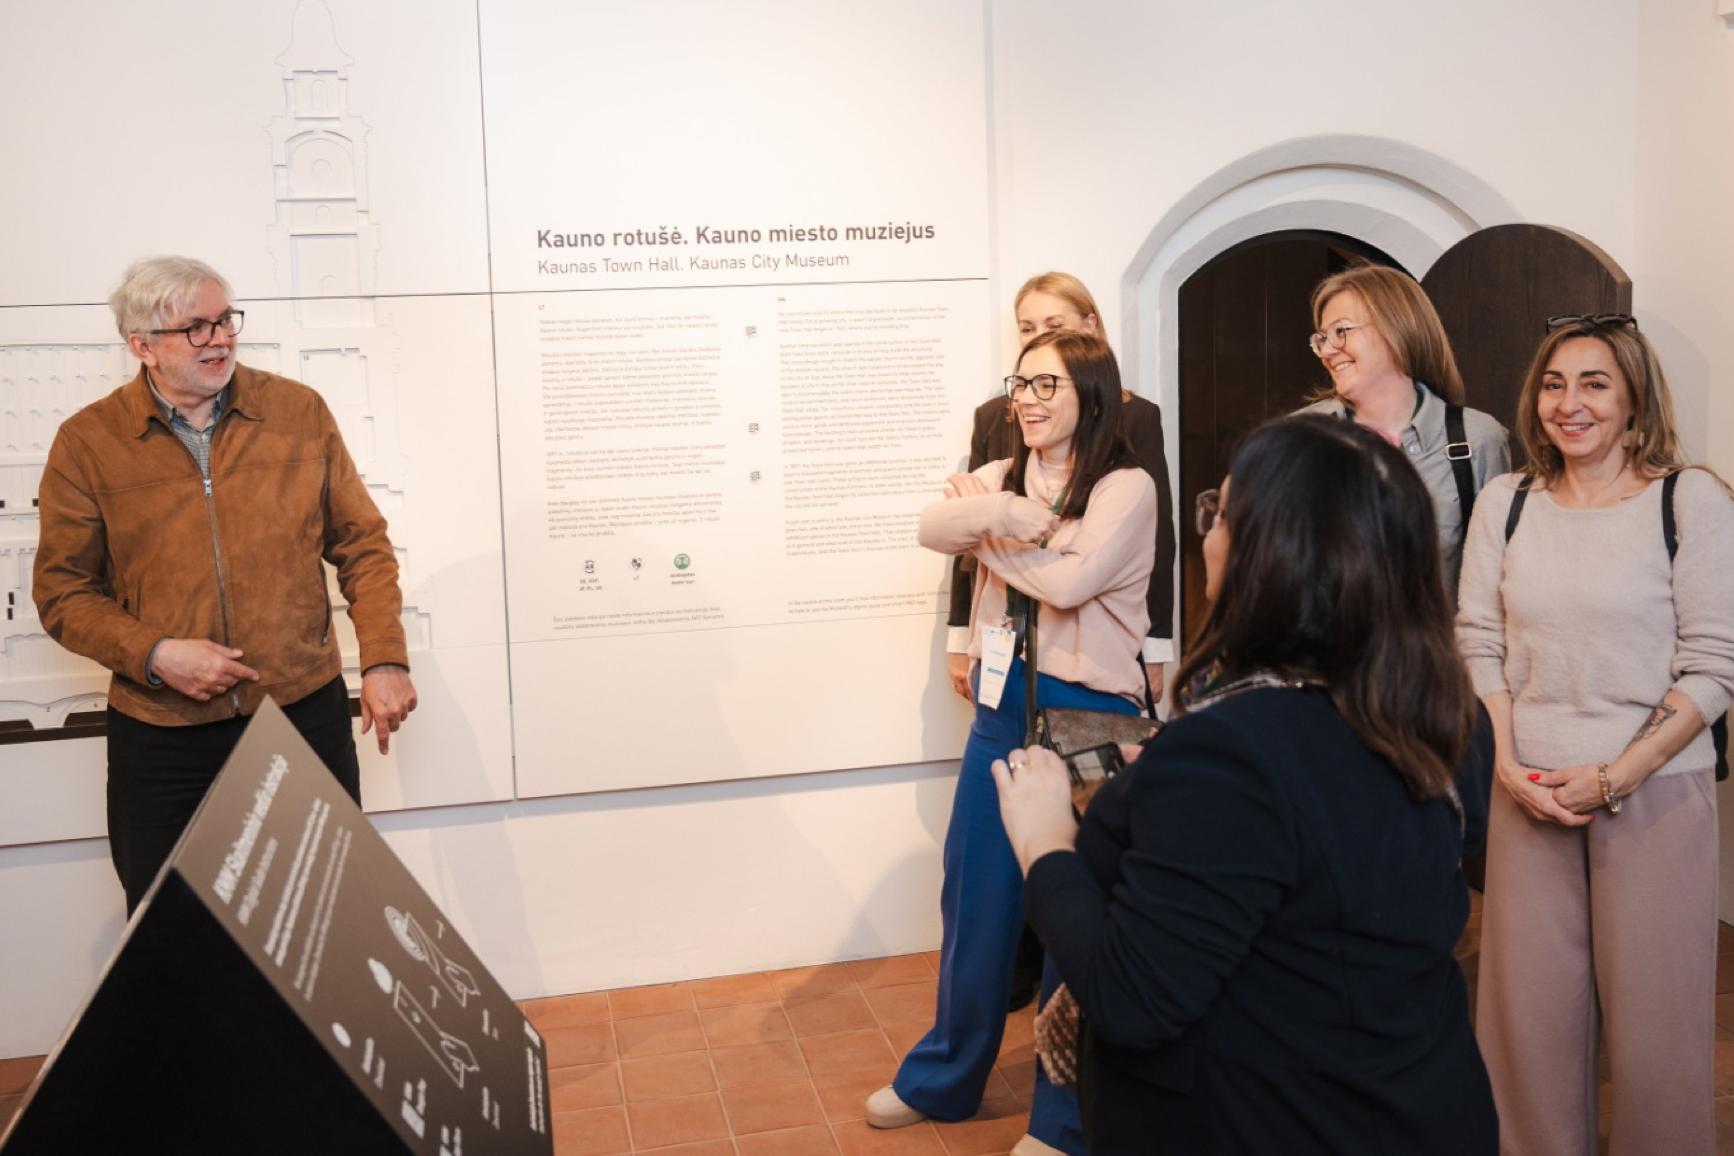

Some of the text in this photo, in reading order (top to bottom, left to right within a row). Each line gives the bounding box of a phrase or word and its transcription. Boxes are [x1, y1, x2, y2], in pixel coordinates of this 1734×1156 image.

[537, 221, 936, 248] Kauno rotušė. Kauno miesto muziejus
[538, 252, 850, 274] Kaunas Town Hall. Kaunas City Museum
